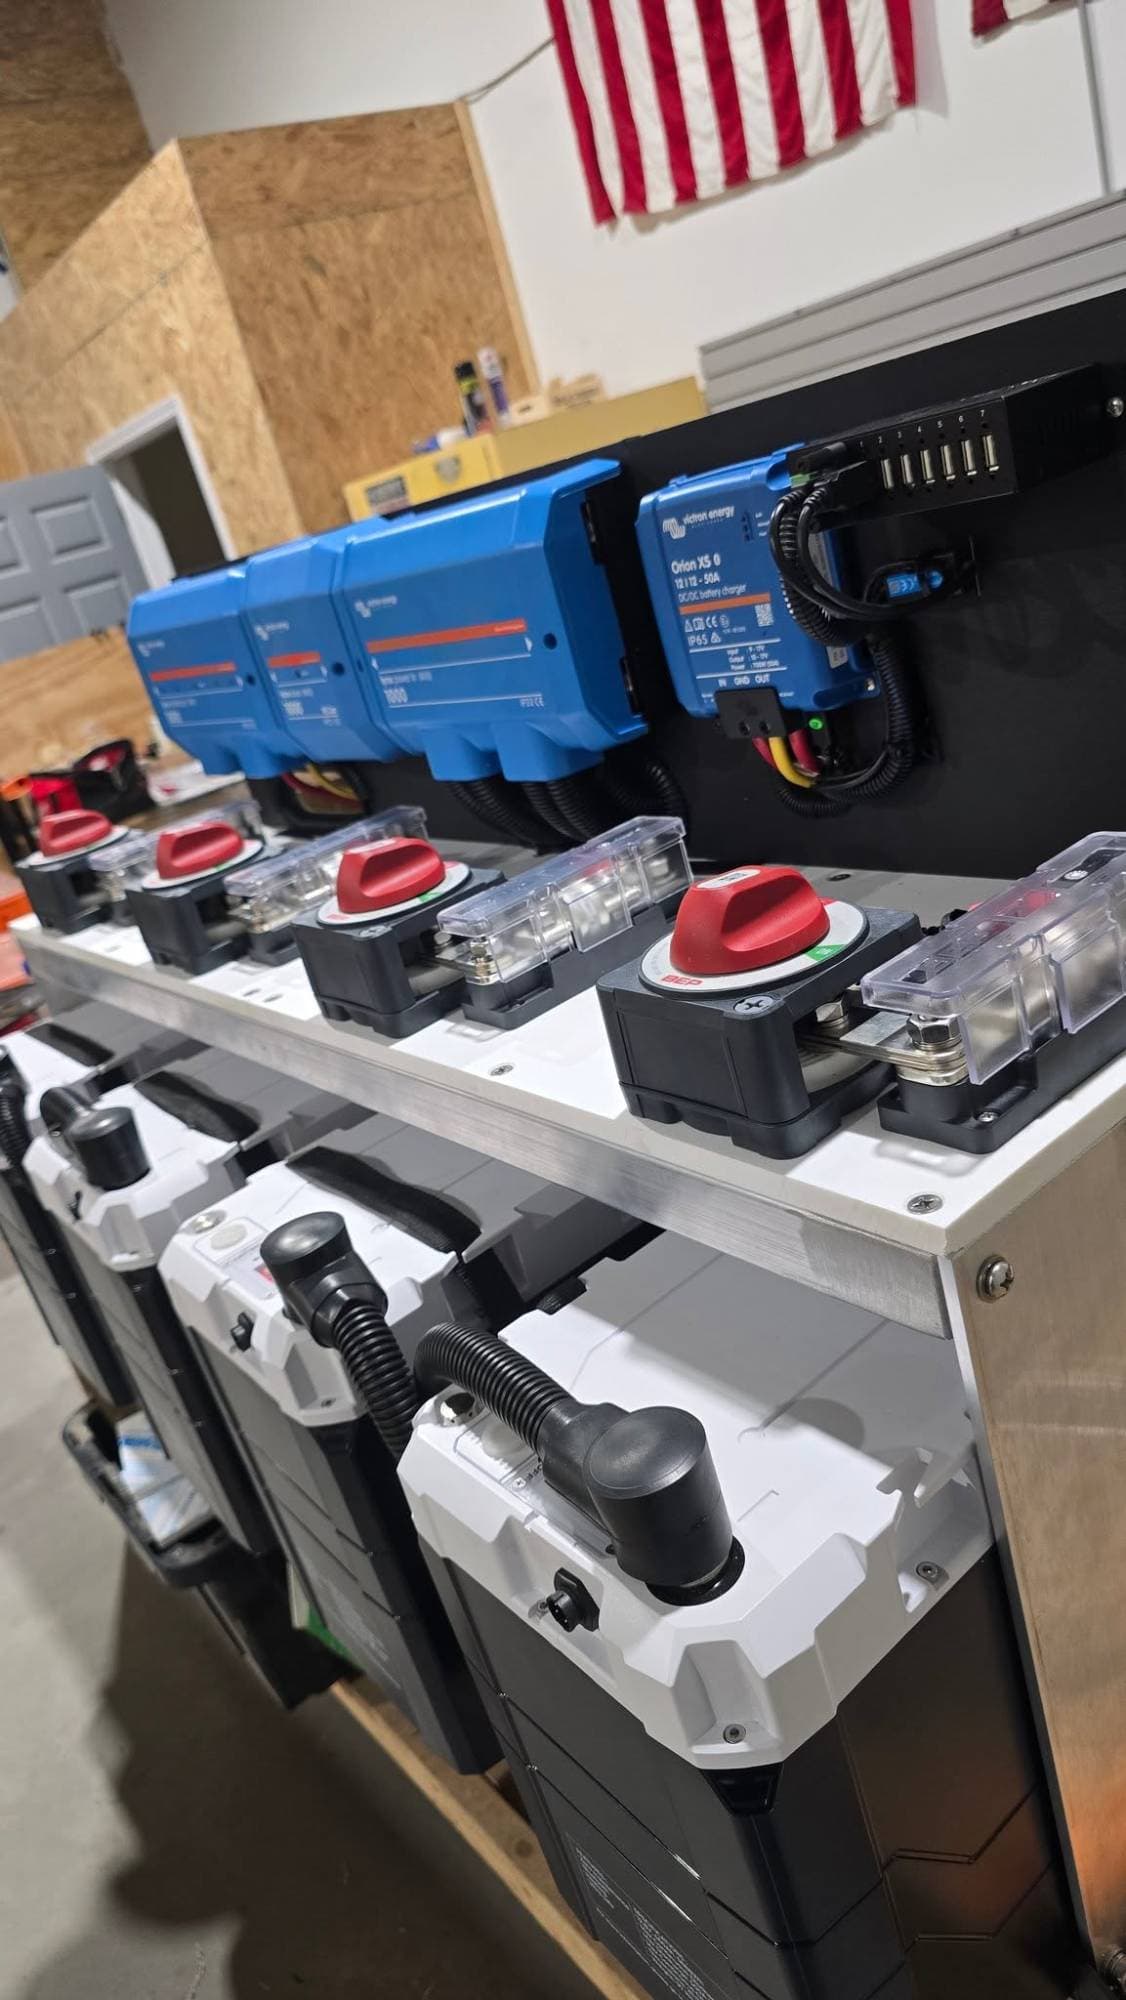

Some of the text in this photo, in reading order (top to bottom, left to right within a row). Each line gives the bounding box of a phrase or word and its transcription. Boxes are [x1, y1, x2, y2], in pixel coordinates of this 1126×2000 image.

[937, 420, 943, 428] 5
[958, 415, 964, 423] 6
[980, 409, 985, 417] 7
[682, 512, 708, 525] victron
[708, 506, 735, 519] energy
[671, 554, 711, 574] Orion XS
[703, 571, 720, 585] 50A
[700, 588, 721, 600] battery
[721, 584, 747, 597] charger
[687, 634, 708, 647] IP65
[718, 673, 770, 688] IN GND OUT
[661, 974, 703, 986] BEP
